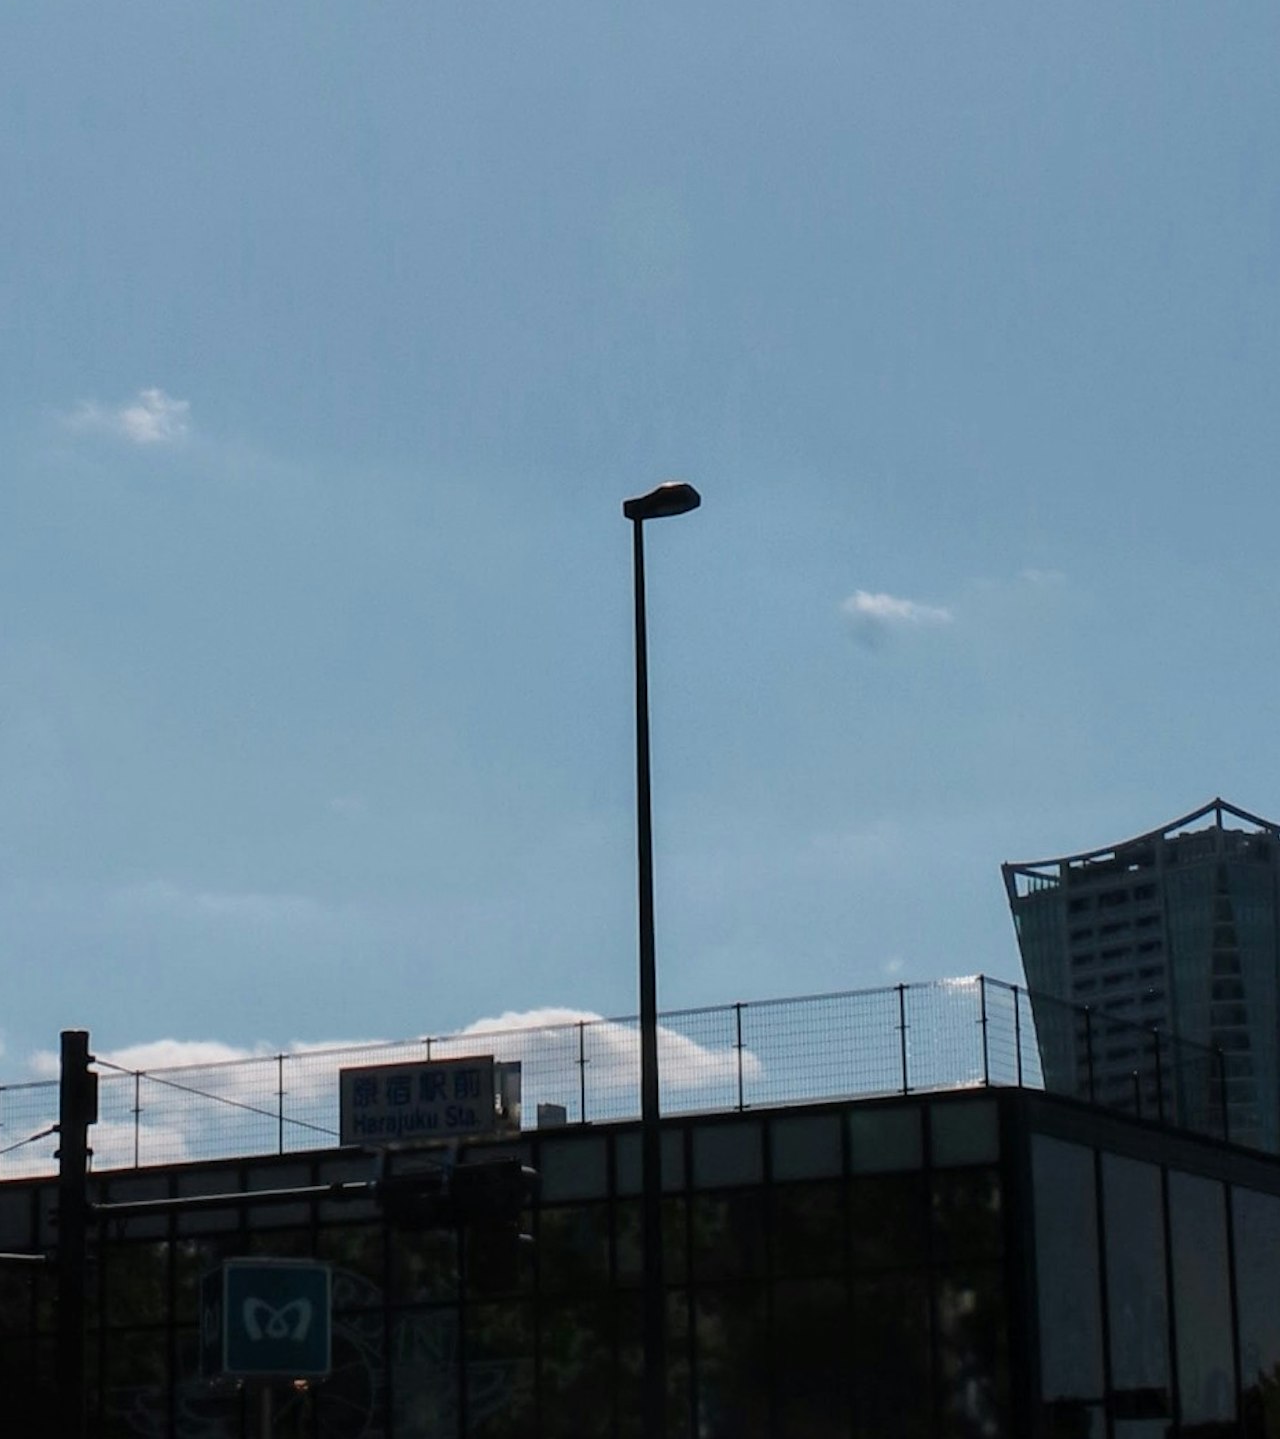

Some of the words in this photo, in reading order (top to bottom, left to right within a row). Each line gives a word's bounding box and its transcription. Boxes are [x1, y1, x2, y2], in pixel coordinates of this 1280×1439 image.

[353, 1069, 481, 1107] 原宿駅前
[353, 1107, 438, 1137] Harajuku
[446, 1105, 480, 1127] Sta.
